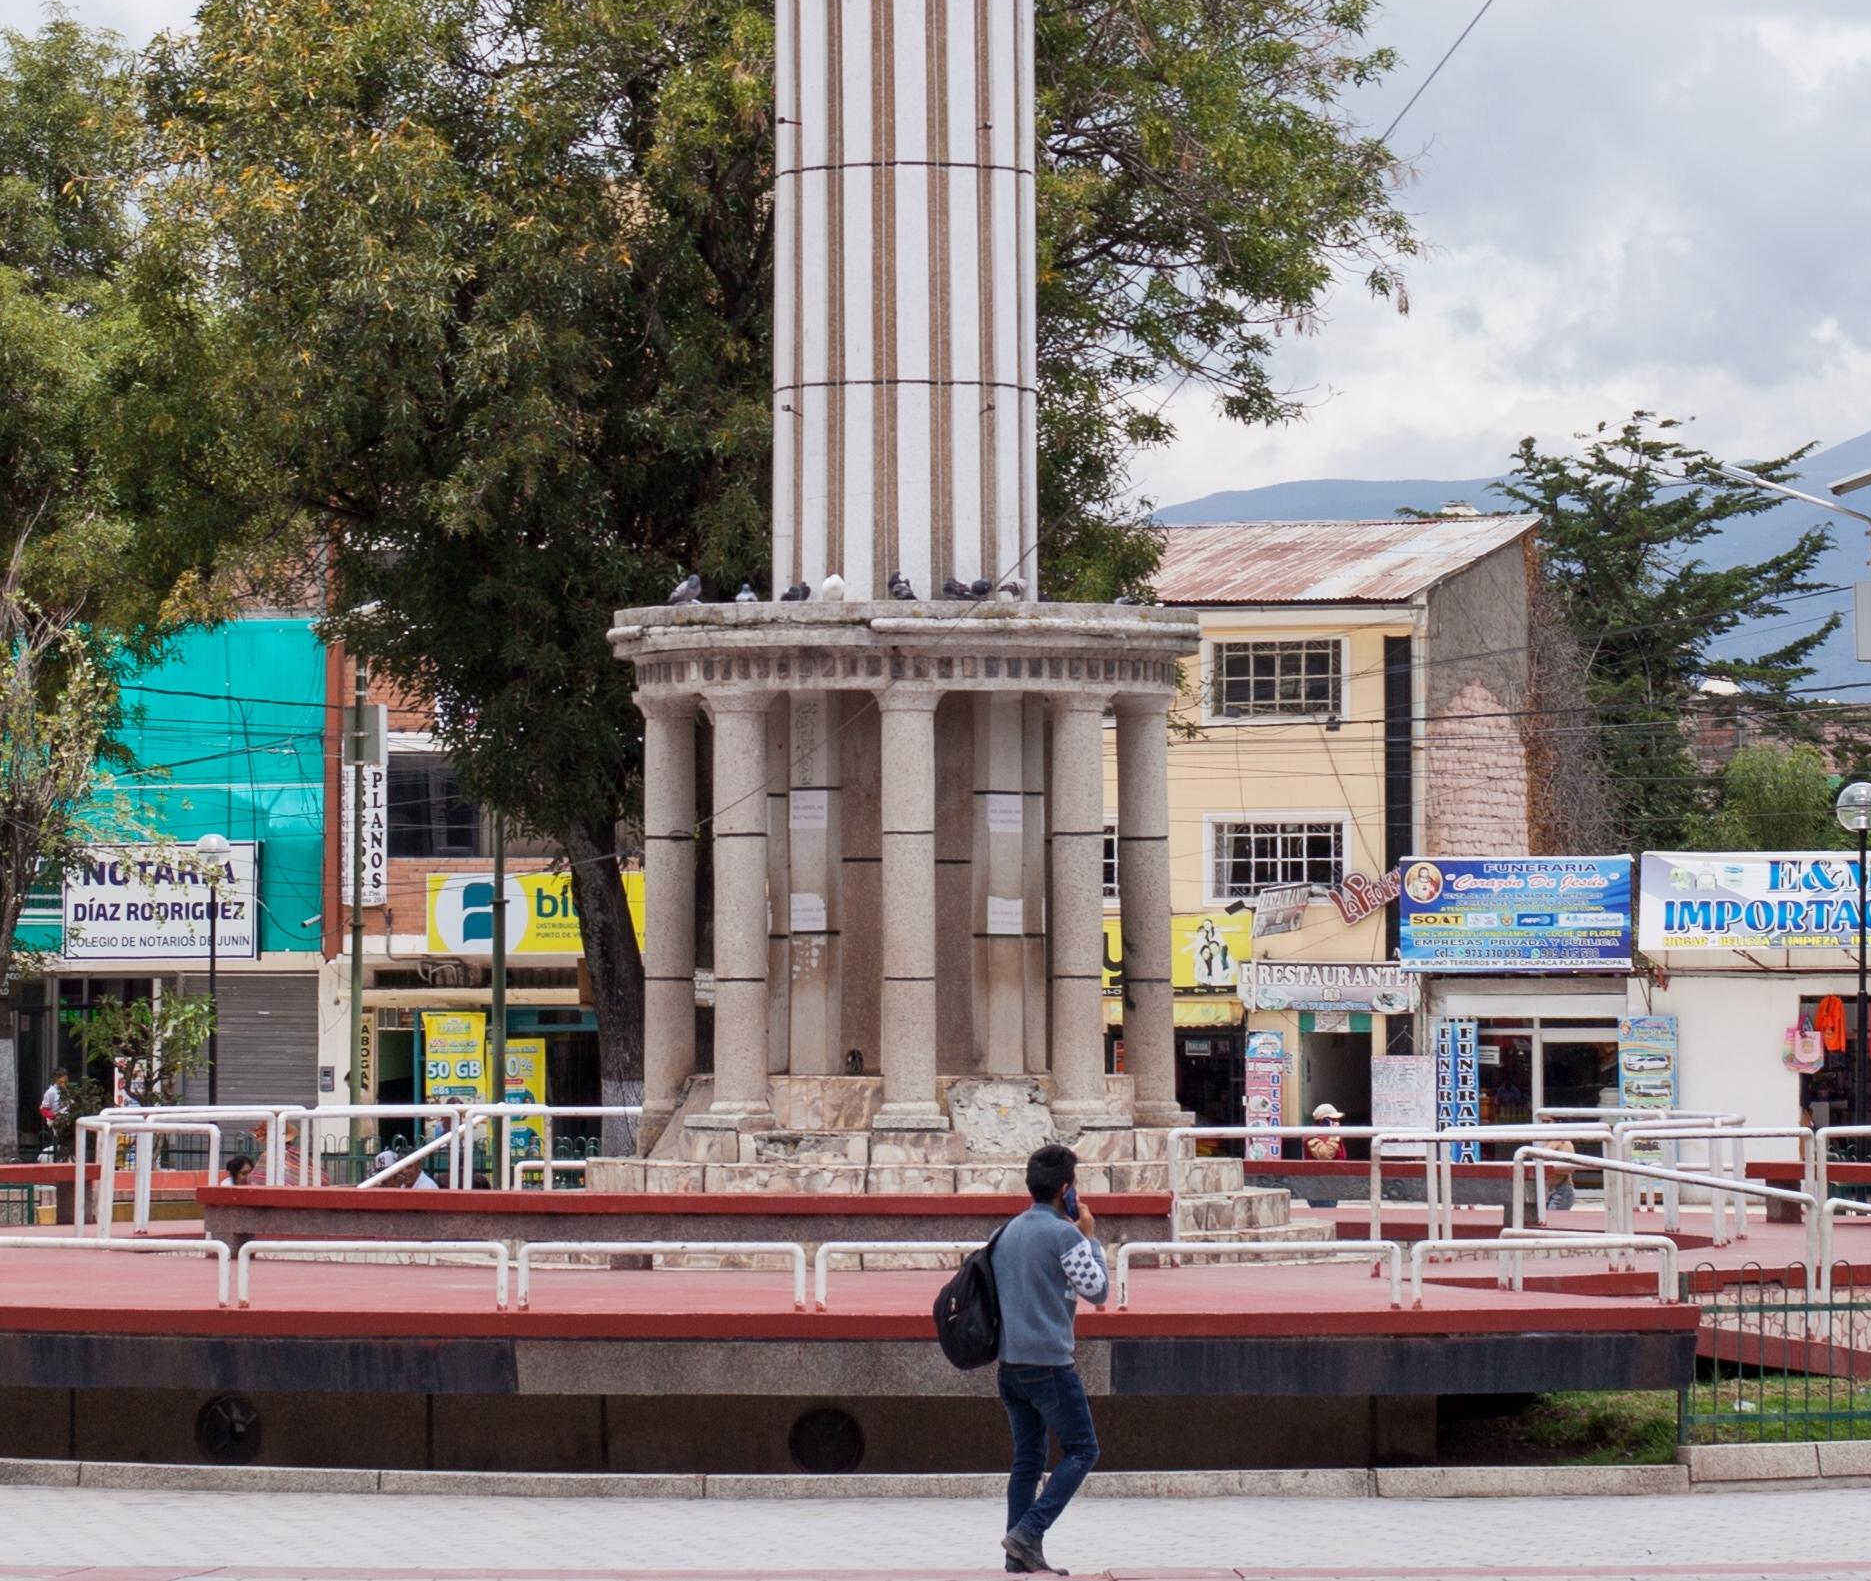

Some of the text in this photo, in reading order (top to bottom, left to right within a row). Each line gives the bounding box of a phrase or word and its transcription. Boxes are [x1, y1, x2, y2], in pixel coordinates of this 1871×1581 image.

[370, 771, 384, 889] PLANOS
[1484, 864, 1597, 873] FUNERARIA
[1528, 874, 1555, 888] De
[73, 897, 245, 921] DÍAZ RODRIGUEZ
[1412, 915, 1462, 925] SOAT
[1589, 930, 1622, 938] FLORES
[69, 936, 118, 948] COLEGIO
[121, 936, 136, 947] DE
[139, 935, 195, 947] NOTARIOS
[1415, 939, 1483, 947] EMPRESAS
[1490, 939, 1548, 947] PRIVADA
[1550, 939, 1560, 947] Y
[1663, 936, 1708, 947] HOGAR
[1718, 935, 1771, 947] BELLEZA
[1782, 935, 1840, 946] LIMPIEZA
[1465, 948, 1482, 958] 973
[1485, 948, 1502, 958] 330
[1504, 948, 1521, 958] 093
[1258, 964, 1407, 987] RESTAURANTE
[427, 1059, 482, 1079] 50 GB
[505, 1056, 533, 1078] 0%
